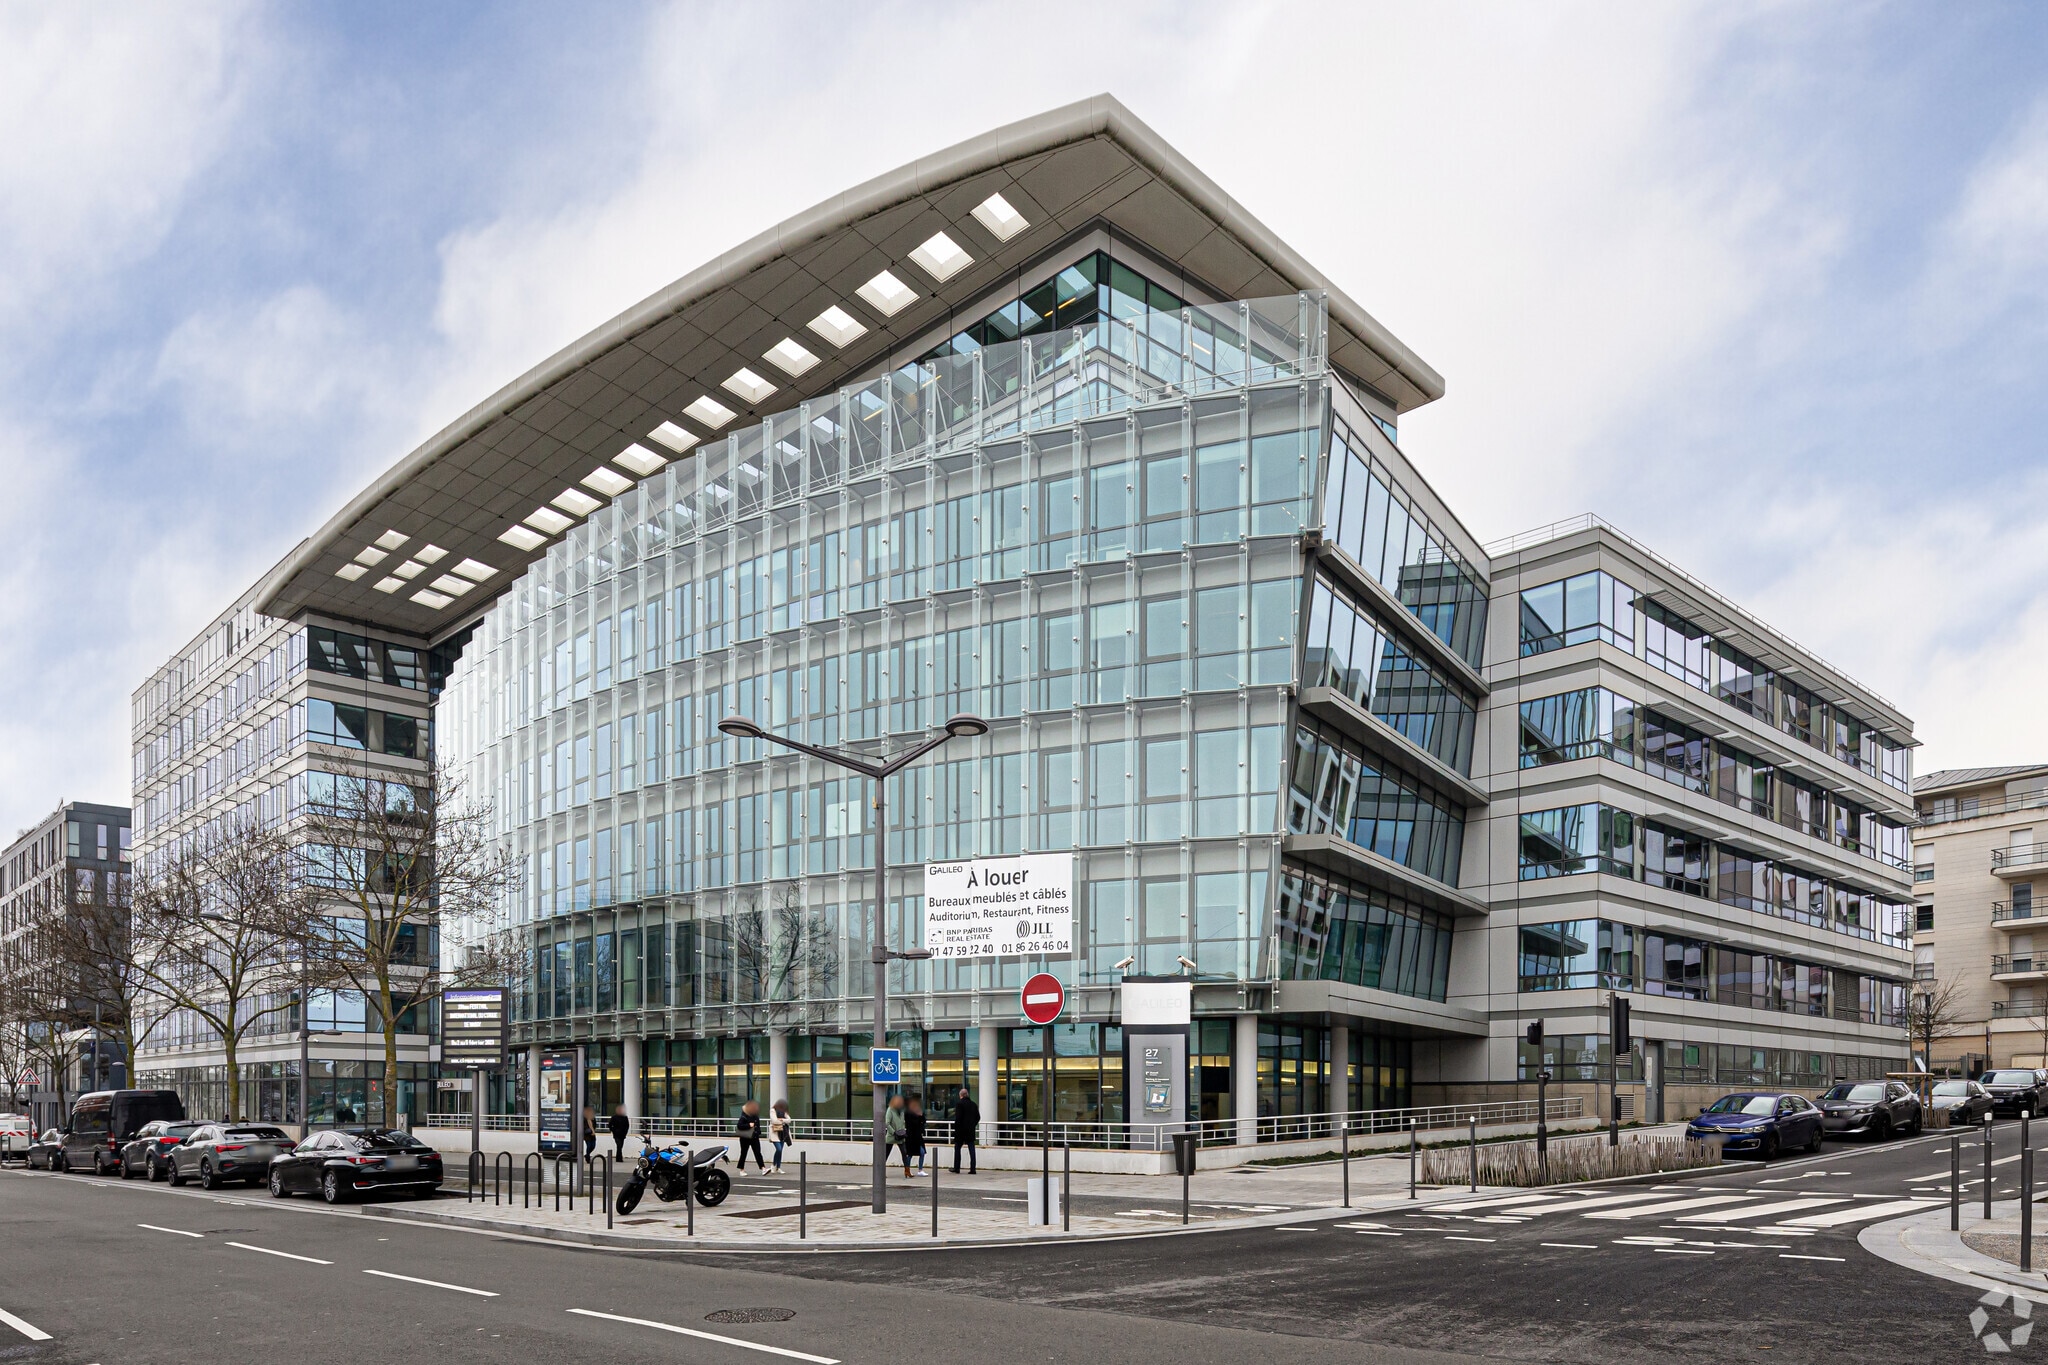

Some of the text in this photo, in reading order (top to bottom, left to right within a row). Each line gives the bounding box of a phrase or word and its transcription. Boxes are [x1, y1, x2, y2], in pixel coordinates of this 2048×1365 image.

[967, 867, 1029, 888] À louer
[929, 887, 1067, 907] Bureaux meublés et câblés
[929, 904, 1070, 921] Auditorium, Restaurant, Fitness
[963, 926, 993, 934] PARIBAS
[1031, 922, 1053, 935] JLL
[965, 934, 991, 942] ESTATE
[929, 947, 940, 957] 01
[942, 946, 954, 956] 47
[956, 945, 967, 956] 59
[982, 943, 994, 953] 40
[1001, 940, 1069, 953] 01 86 26 46 04
[1145, 1048, 1159, 1057] 27
